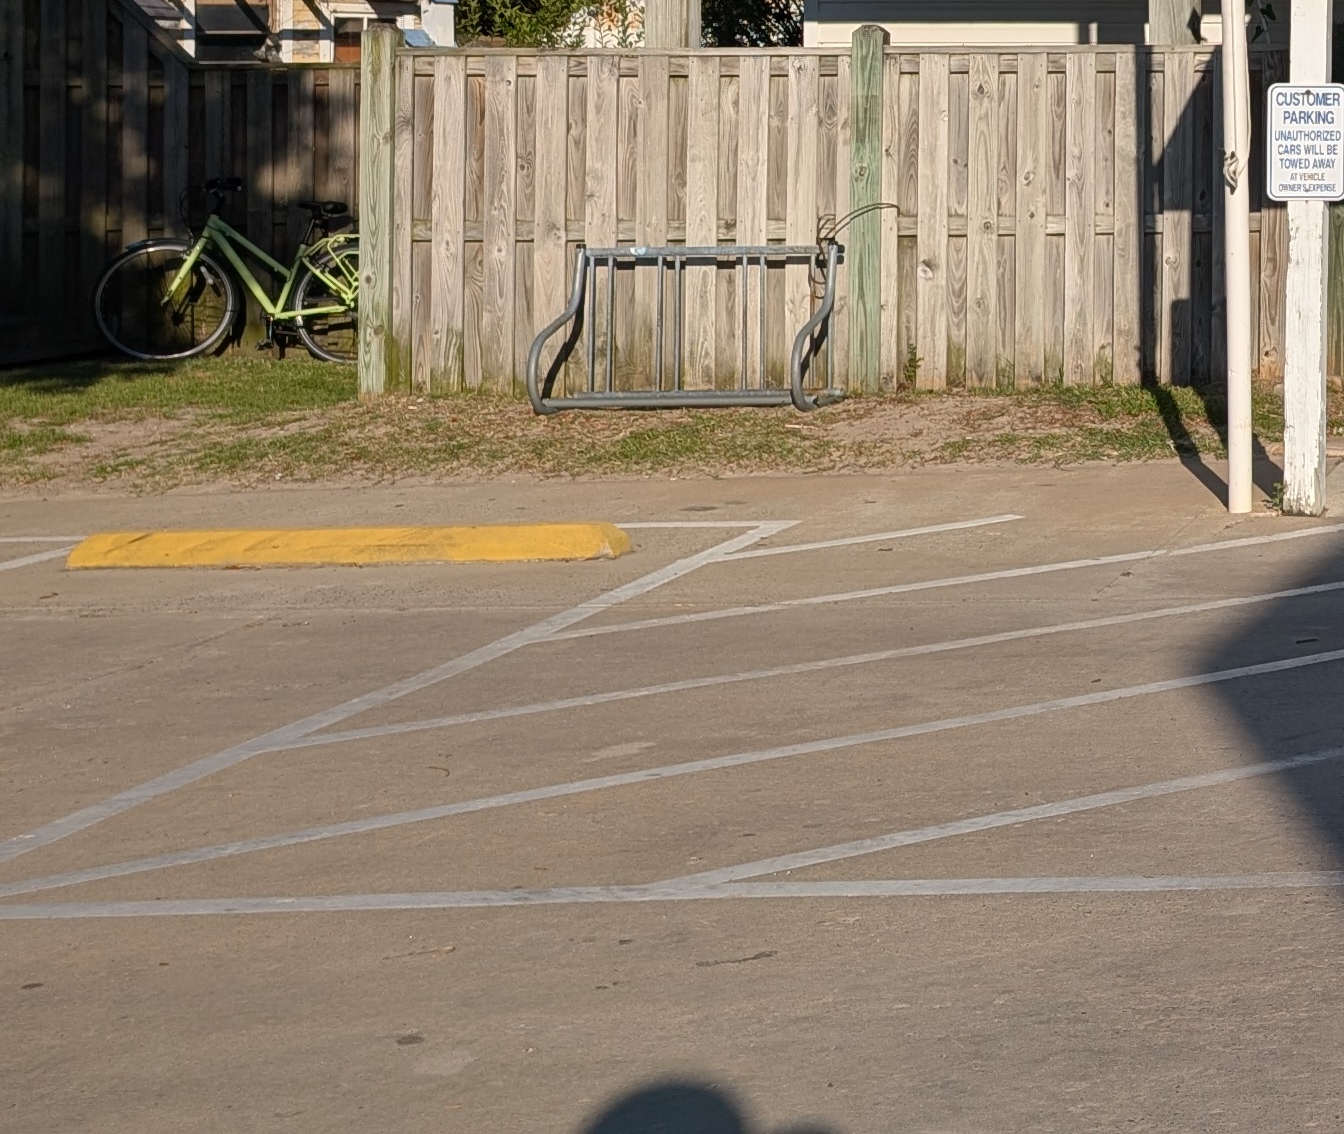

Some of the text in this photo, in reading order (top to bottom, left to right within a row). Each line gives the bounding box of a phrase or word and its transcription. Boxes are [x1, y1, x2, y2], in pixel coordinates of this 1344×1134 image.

[1276, 92, 1340, 106] CUSTOMER
[1283, 111, 1334, 124] PARKING
[1275, 130, 1341, 141] UNAUTHORIZED
[1278, 144, 1338, 155] CARS WILL BE
[1279, 158, 1336, 169] TOWED AWAY
[1290, 173, 1325, 181] AT VEHICLE
